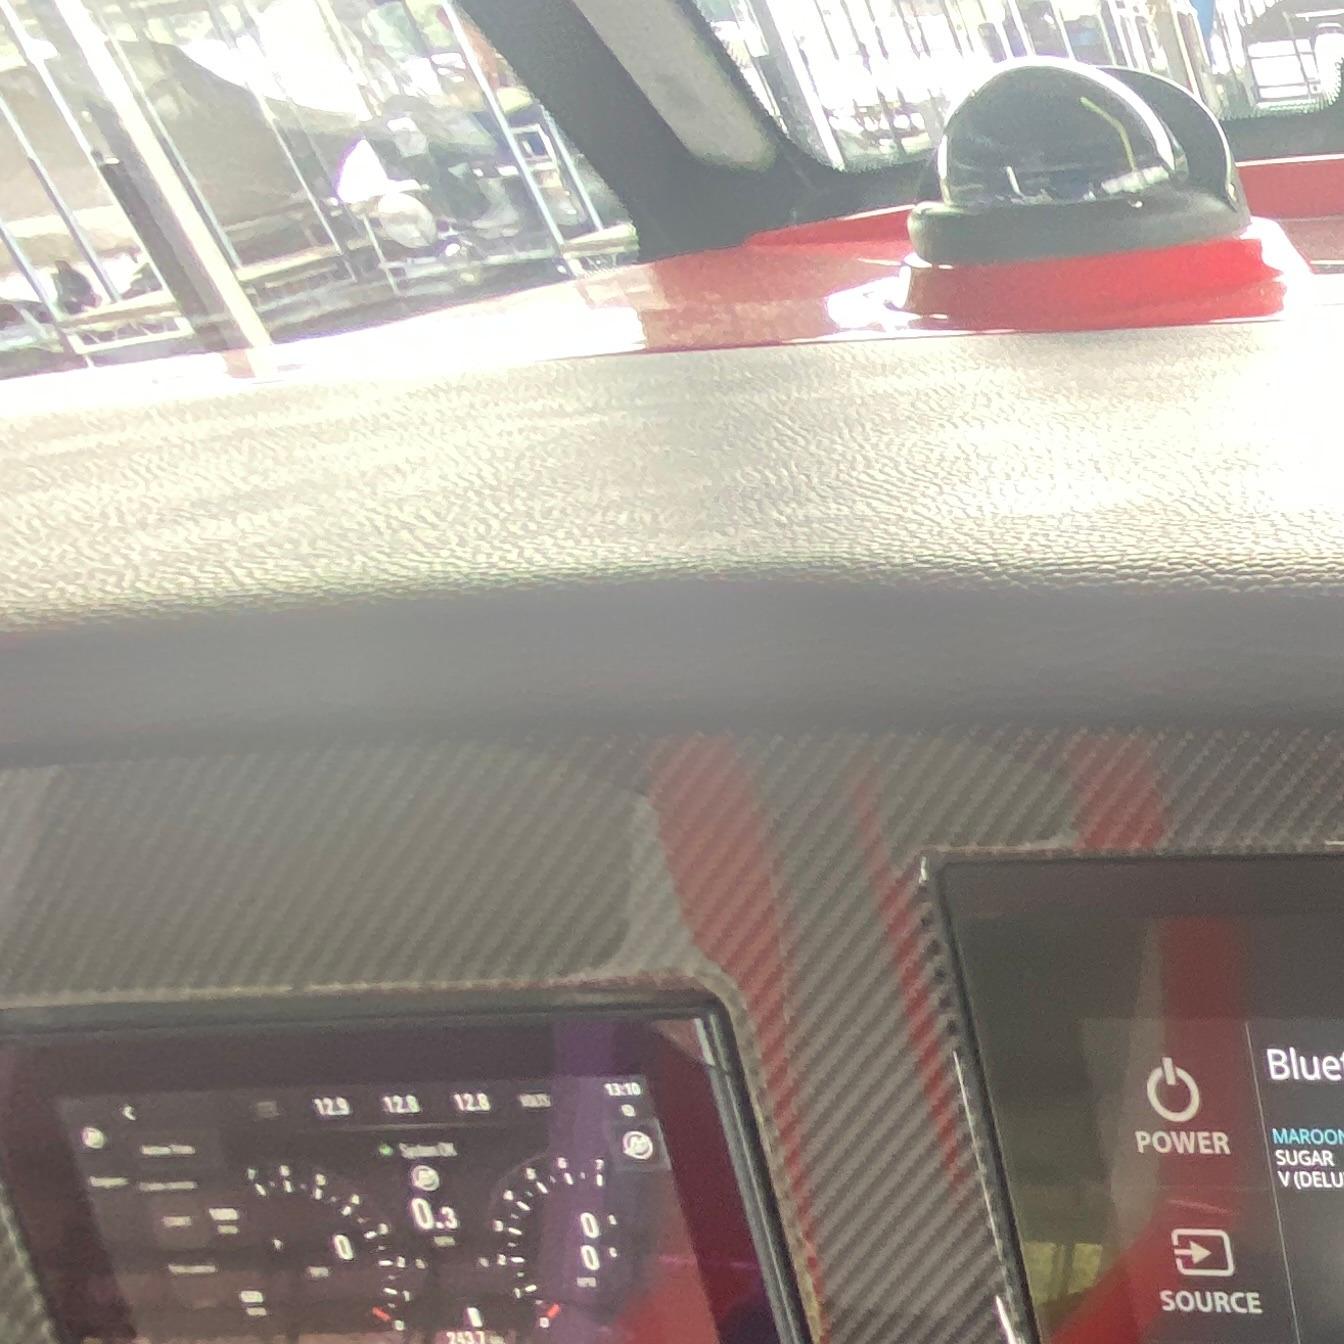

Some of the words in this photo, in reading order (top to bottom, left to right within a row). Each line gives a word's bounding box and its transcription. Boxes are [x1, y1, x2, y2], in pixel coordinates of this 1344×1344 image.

[454, 1093, 491, 1111] 12.8
[604, 1083, 641, 1096] 13:10
[1135, 1130, 1231, 1156] POWER
[1275, 1149, 1335, 1167] SUGAR
[1278, 1171, 1290, 1188] V
[411, 1198, 458, 1230] 0.3
[581, 1212, 600, 1238] 0
[334, 1234, 354, 1260] 0
[581, 1245, 600, 1270] 0
[1160, 1289, 1263, 1314] SOURCE
